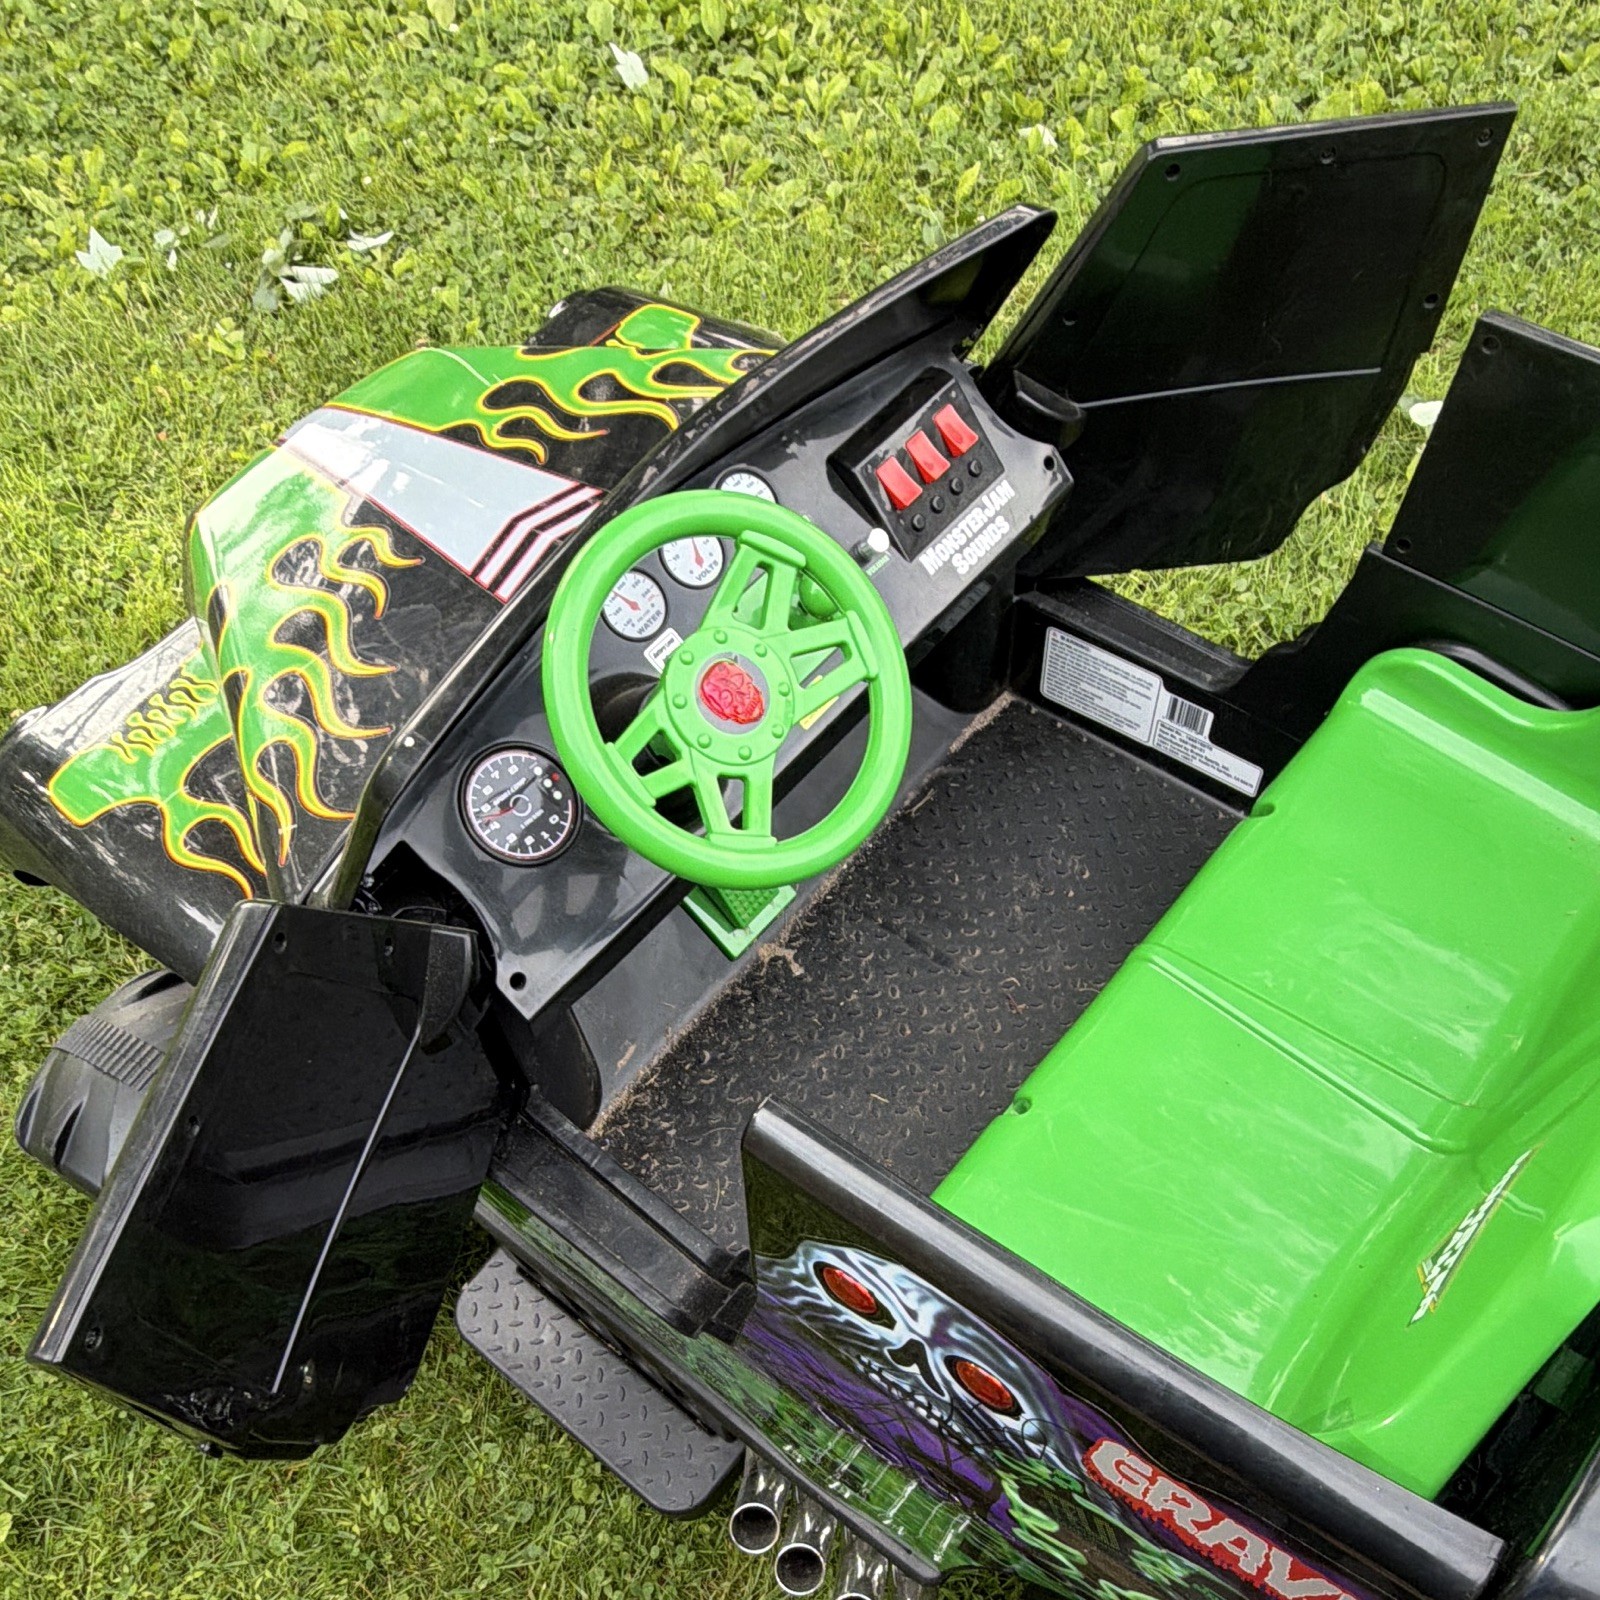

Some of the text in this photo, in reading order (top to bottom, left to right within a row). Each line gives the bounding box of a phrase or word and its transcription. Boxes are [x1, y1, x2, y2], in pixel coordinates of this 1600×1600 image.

[951, 515, 1010, 575] SOUNDS
[695, 559, 719, 582] VOLTS
[636, 609, 663, 635] WATER
[1085, 1438, 1356, 1600] GRAV
